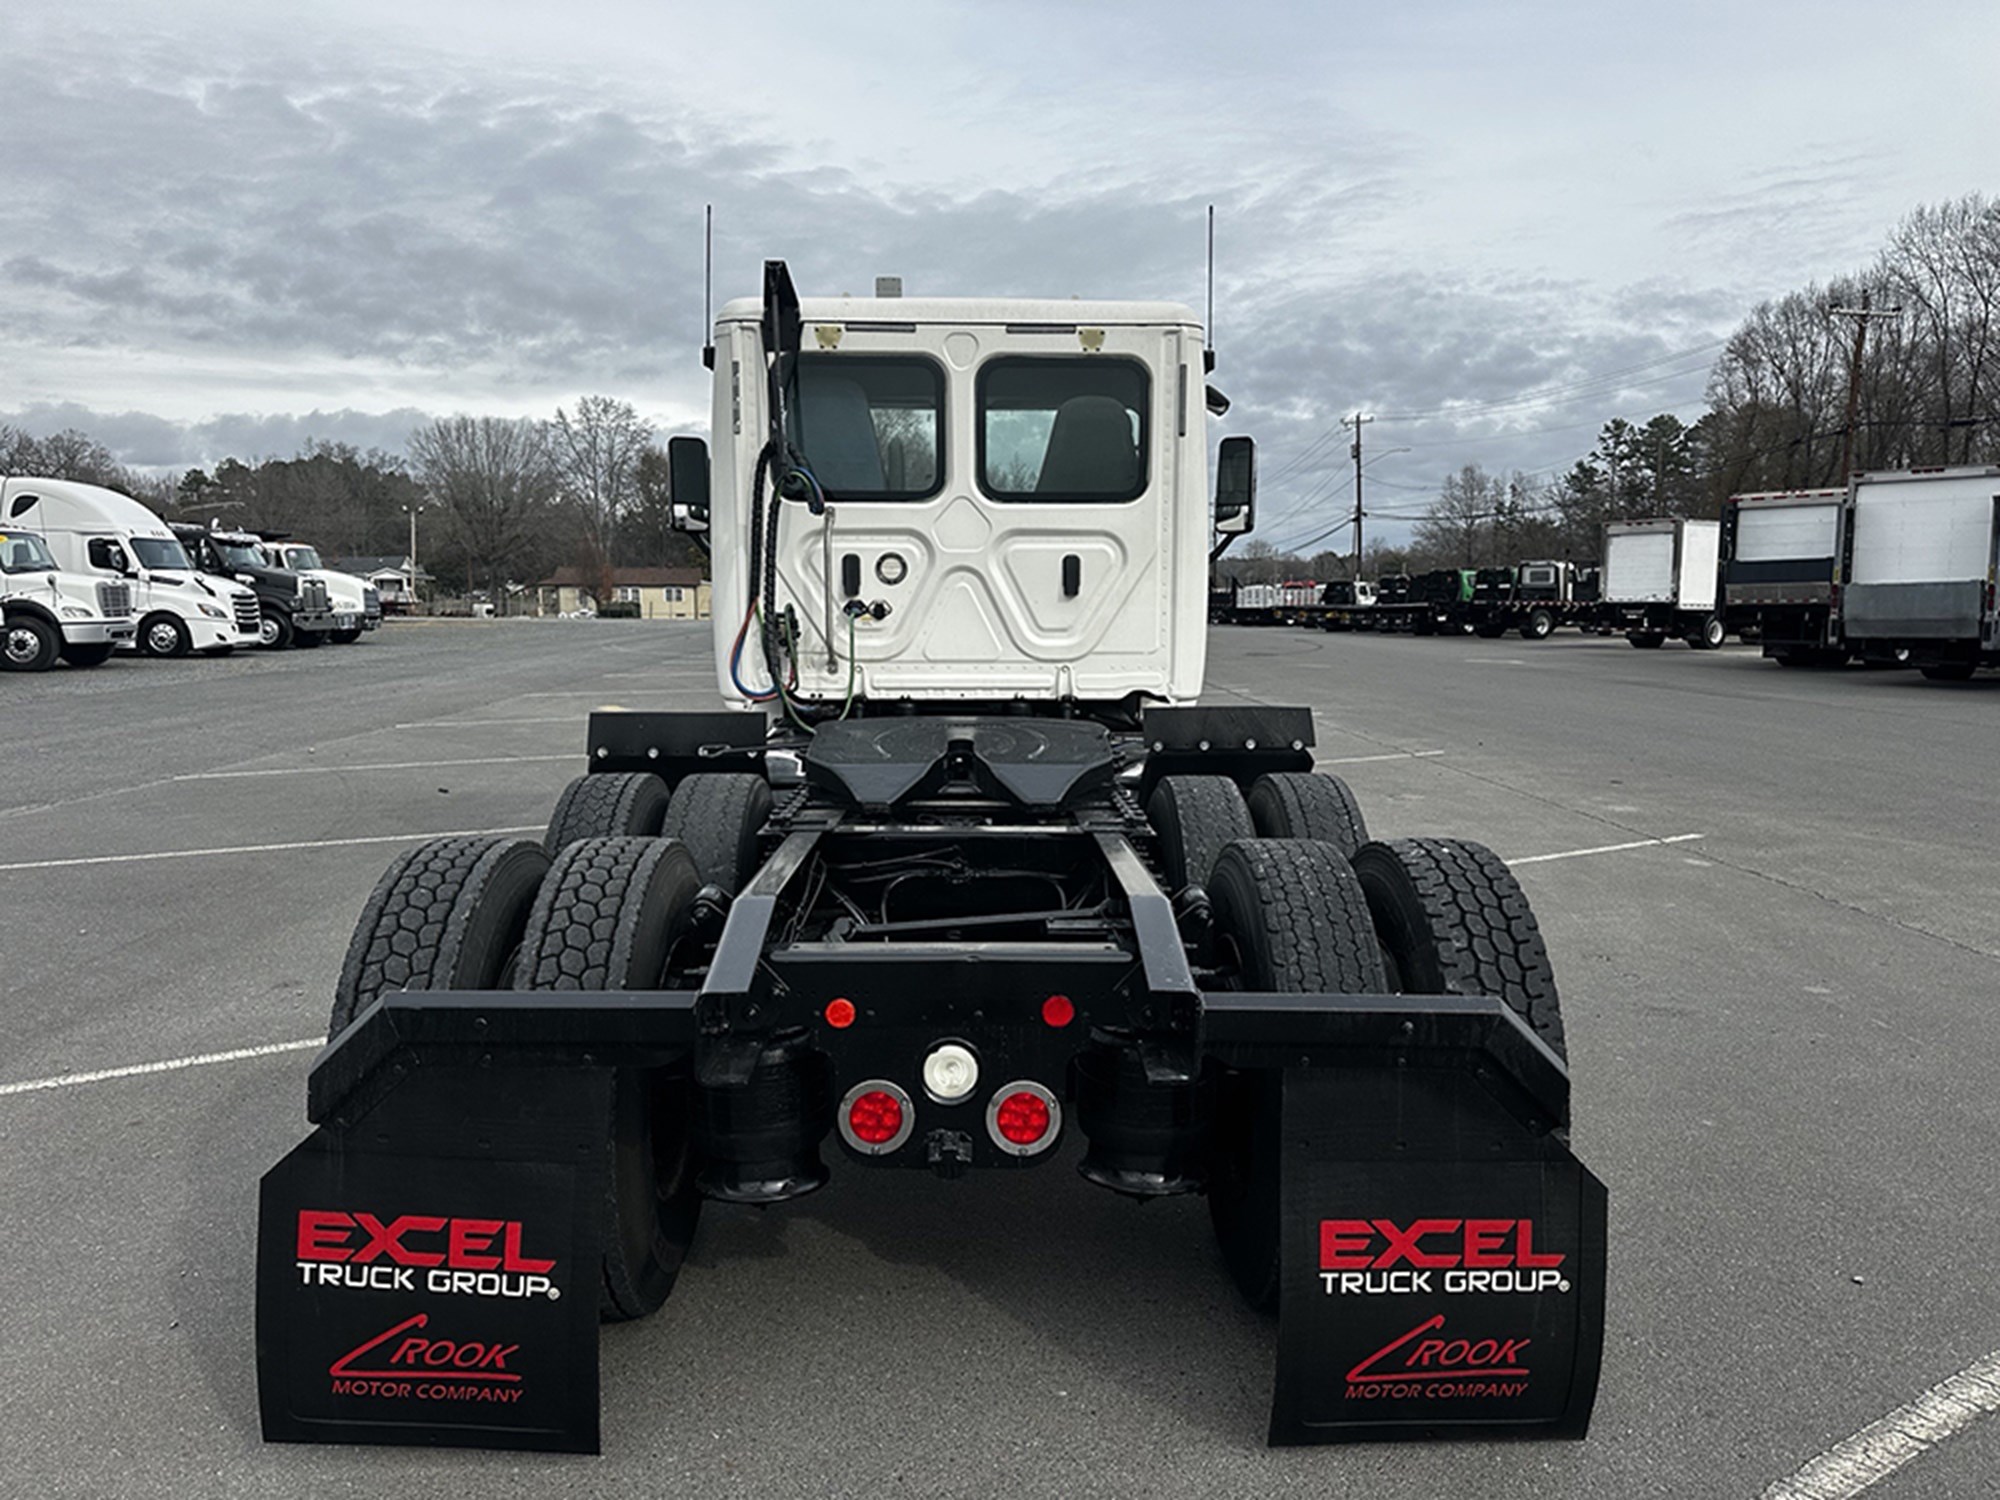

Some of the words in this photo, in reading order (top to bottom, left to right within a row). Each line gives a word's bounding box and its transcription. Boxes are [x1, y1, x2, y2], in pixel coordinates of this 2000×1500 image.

[296, 1210, 557, 1274] EXCEL
[1319, 1219, 1565, 1270] EXCEL
[296, 1262, 415, 1291] TRUCK
[1319, 1270, 1432, 1294] TRUCK
[331, 1380, 411, 1398] MOTOR
[415, 1384, 523, 1402] COMPANY
[1344, 1384, 1421, 1399] MOTOR
[1425, 1382, 1528, 1399] COMPANY
